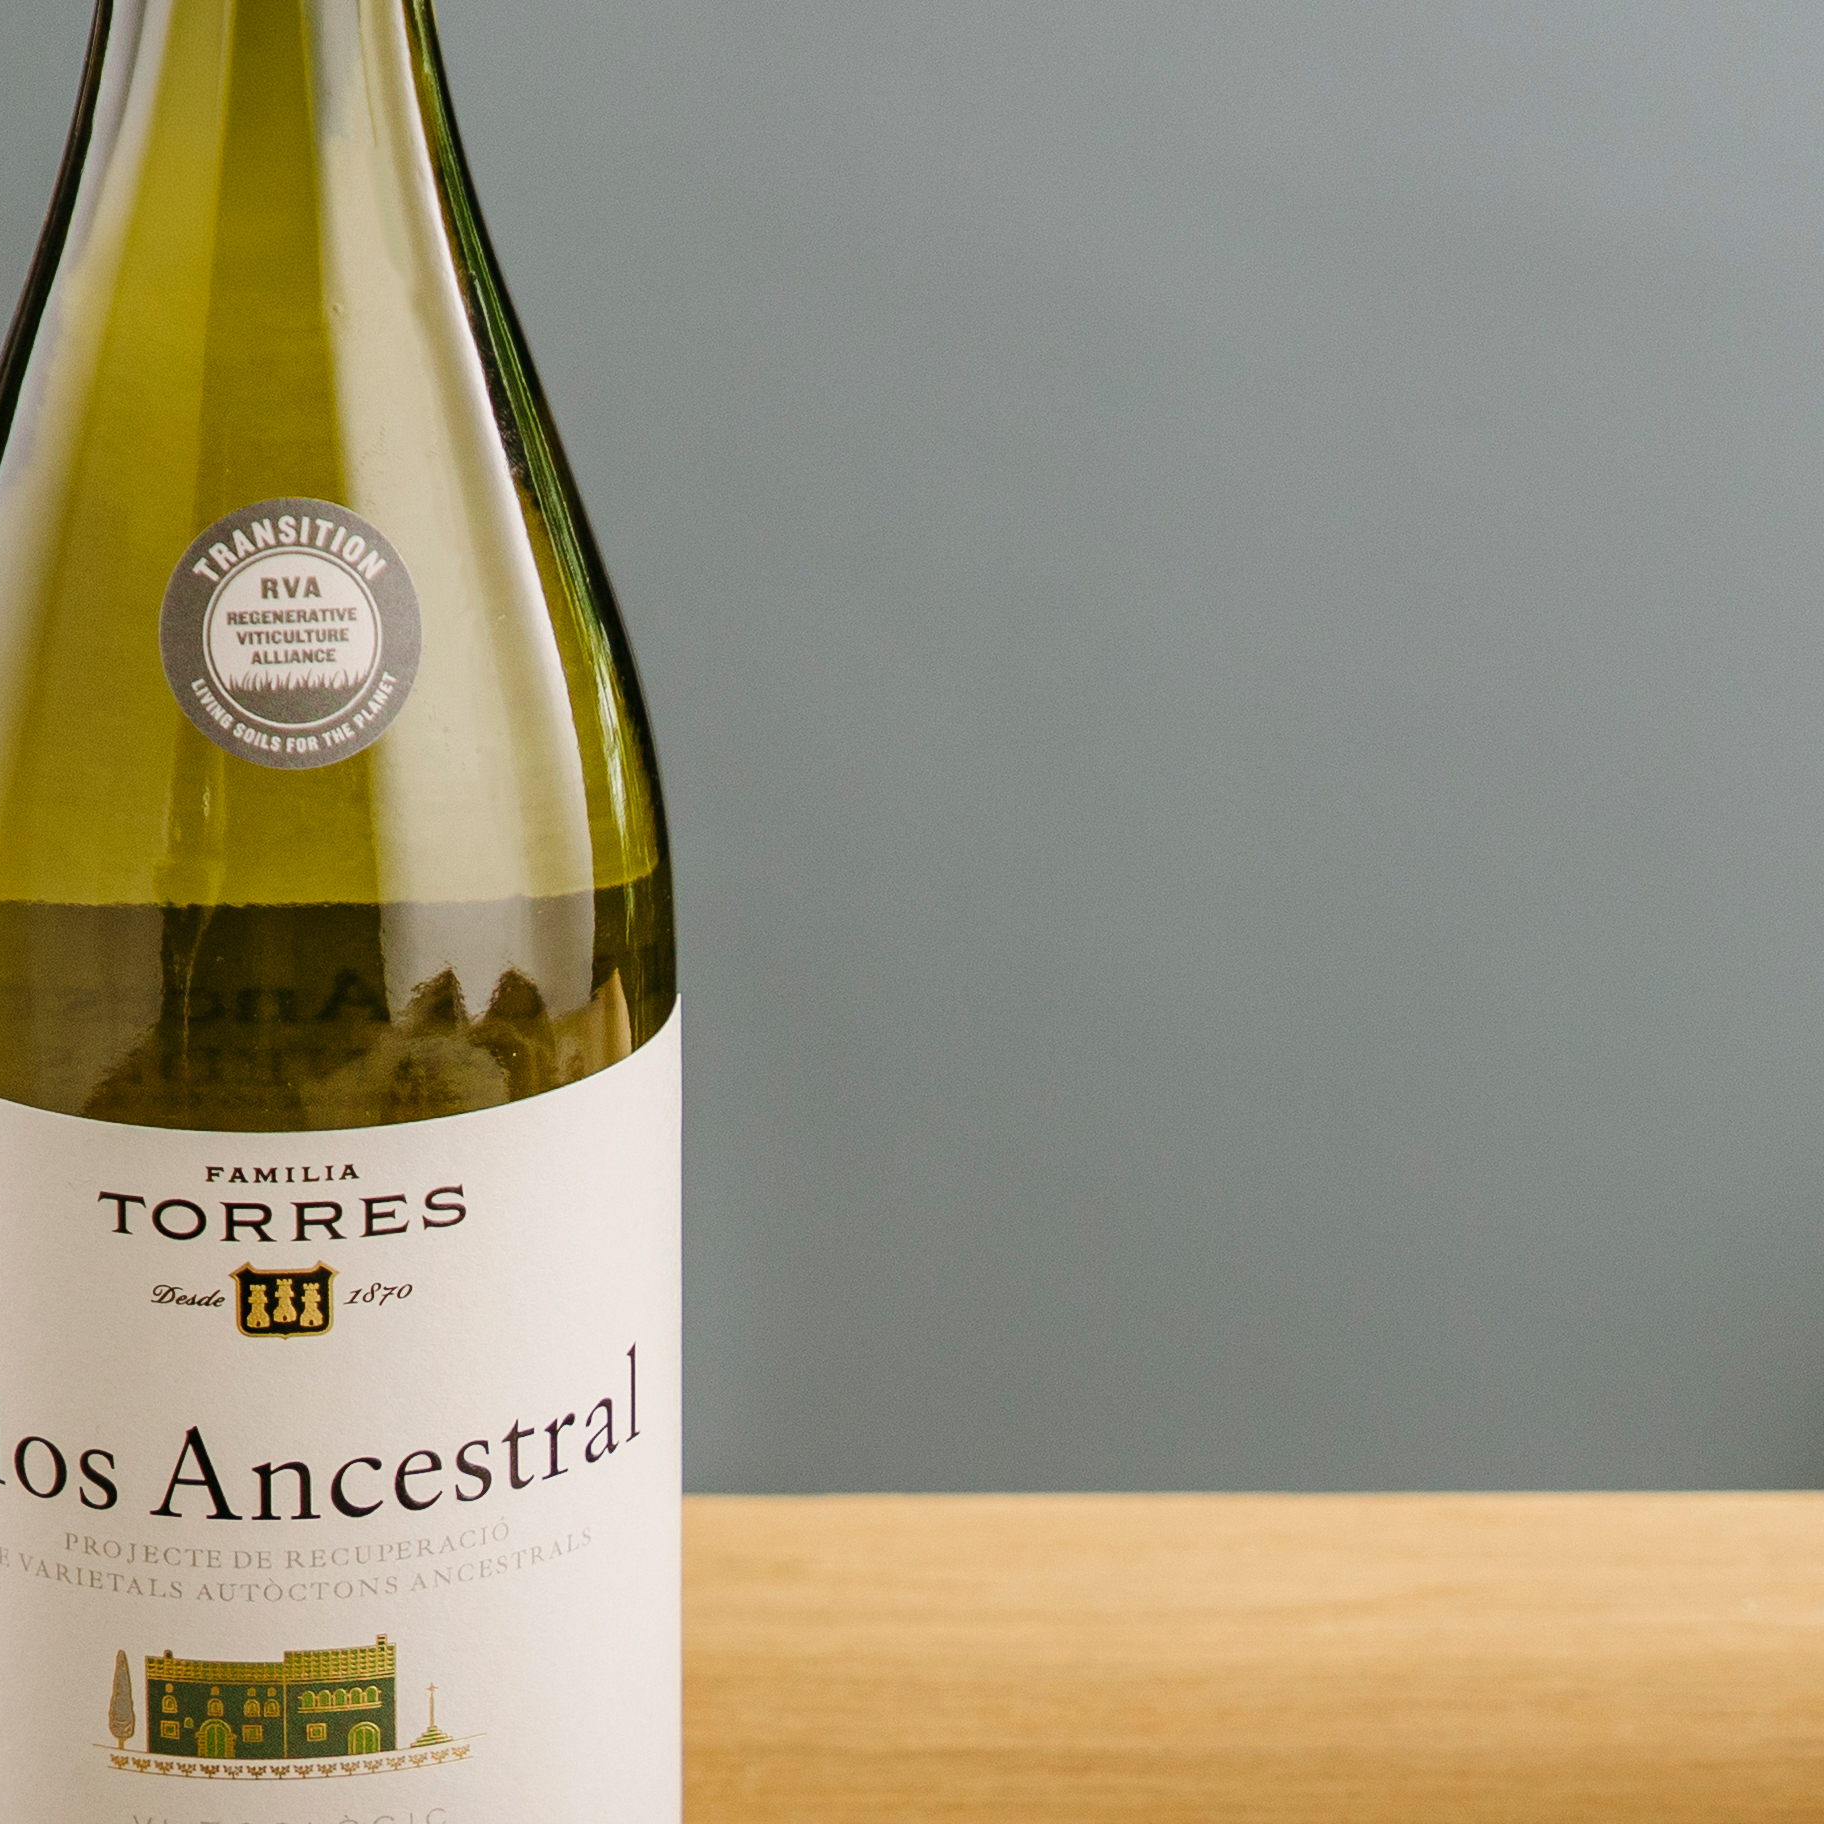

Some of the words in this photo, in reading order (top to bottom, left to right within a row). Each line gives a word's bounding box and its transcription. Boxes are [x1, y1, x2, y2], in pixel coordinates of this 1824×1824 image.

[192, 515, 387, 582] TRANSITION
[261, 576, 322, 599] RVA
[227, 607, 357, 625] REGENERATIVE
[236, 628, 349, 645] VITICULTURE
[251, 649, 336, 665] ALLIANCE
[191, 678, 235, 729] LIVING
[234, 722, 281, 752] SOILS
[286, 736, 319, 753] FOR
[325, 724, 354, 747] THE
[356, 672, 397, 729] PLANET
[205, 1164, 359, 1184] FAMILIA
[97, 1184, 466, 1242] TORRES
[150, 1283, 225, 1309] Desde
[343, 1283, 412, 1306] 1870
[149, 1341, 641, 1522] Ancestral
[63, 1532, 222, 1569] PROJECTE
[233, 1550, 273, 1571] DE
[285, 1519, 511, 1570] RECUPERACIÓ
[18, 1555, 183, 1600] VARIETALS
[195, 1576, 400, 1603] AUTÒCTONS
[409, 1528, 593, 1593] ANCESTRALS
